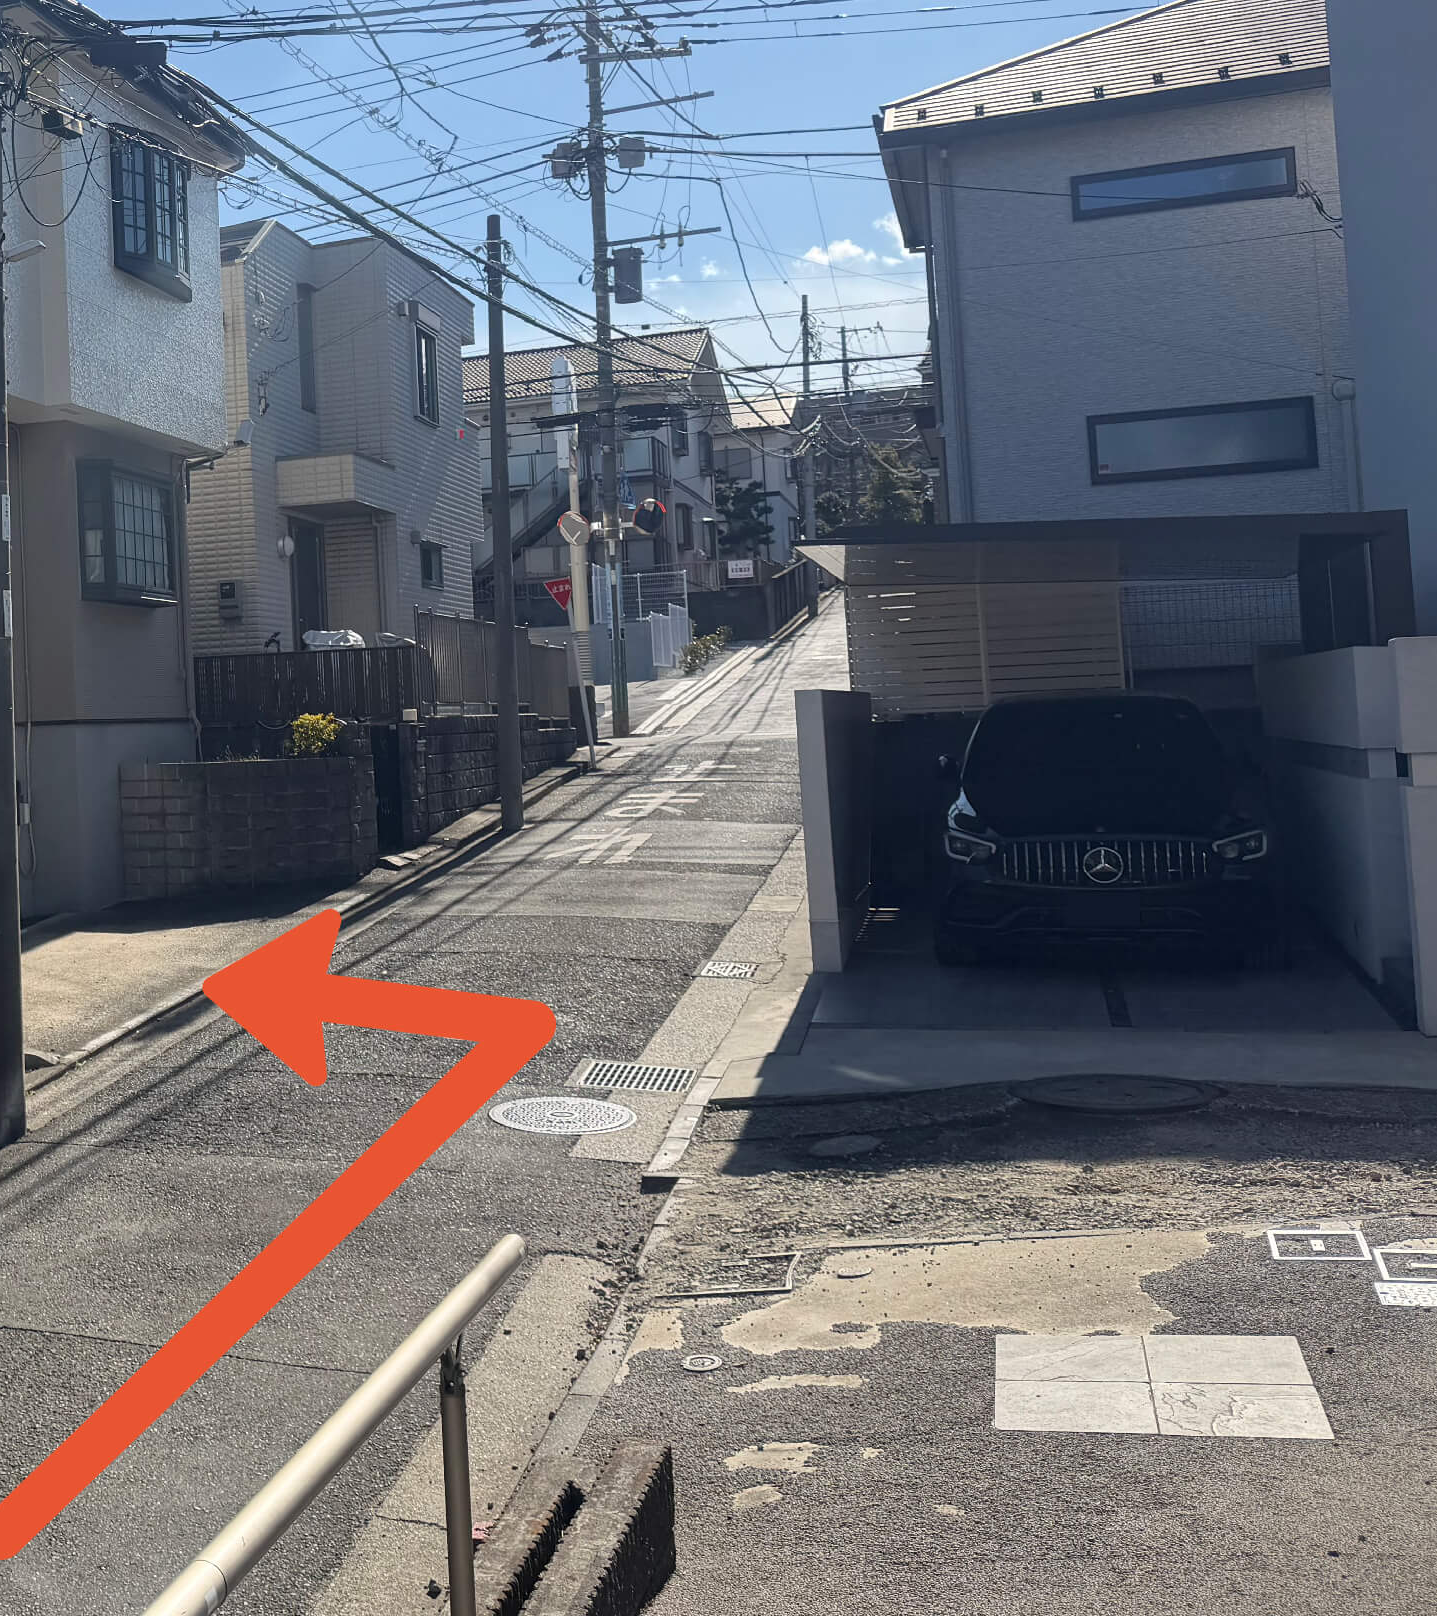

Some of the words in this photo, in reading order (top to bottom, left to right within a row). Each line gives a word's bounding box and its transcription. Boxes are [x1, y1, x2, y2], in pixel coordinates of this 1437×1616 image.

[552, 584, 572, 593] 止まれ
[544, 760, 736, 864] 止まれ
